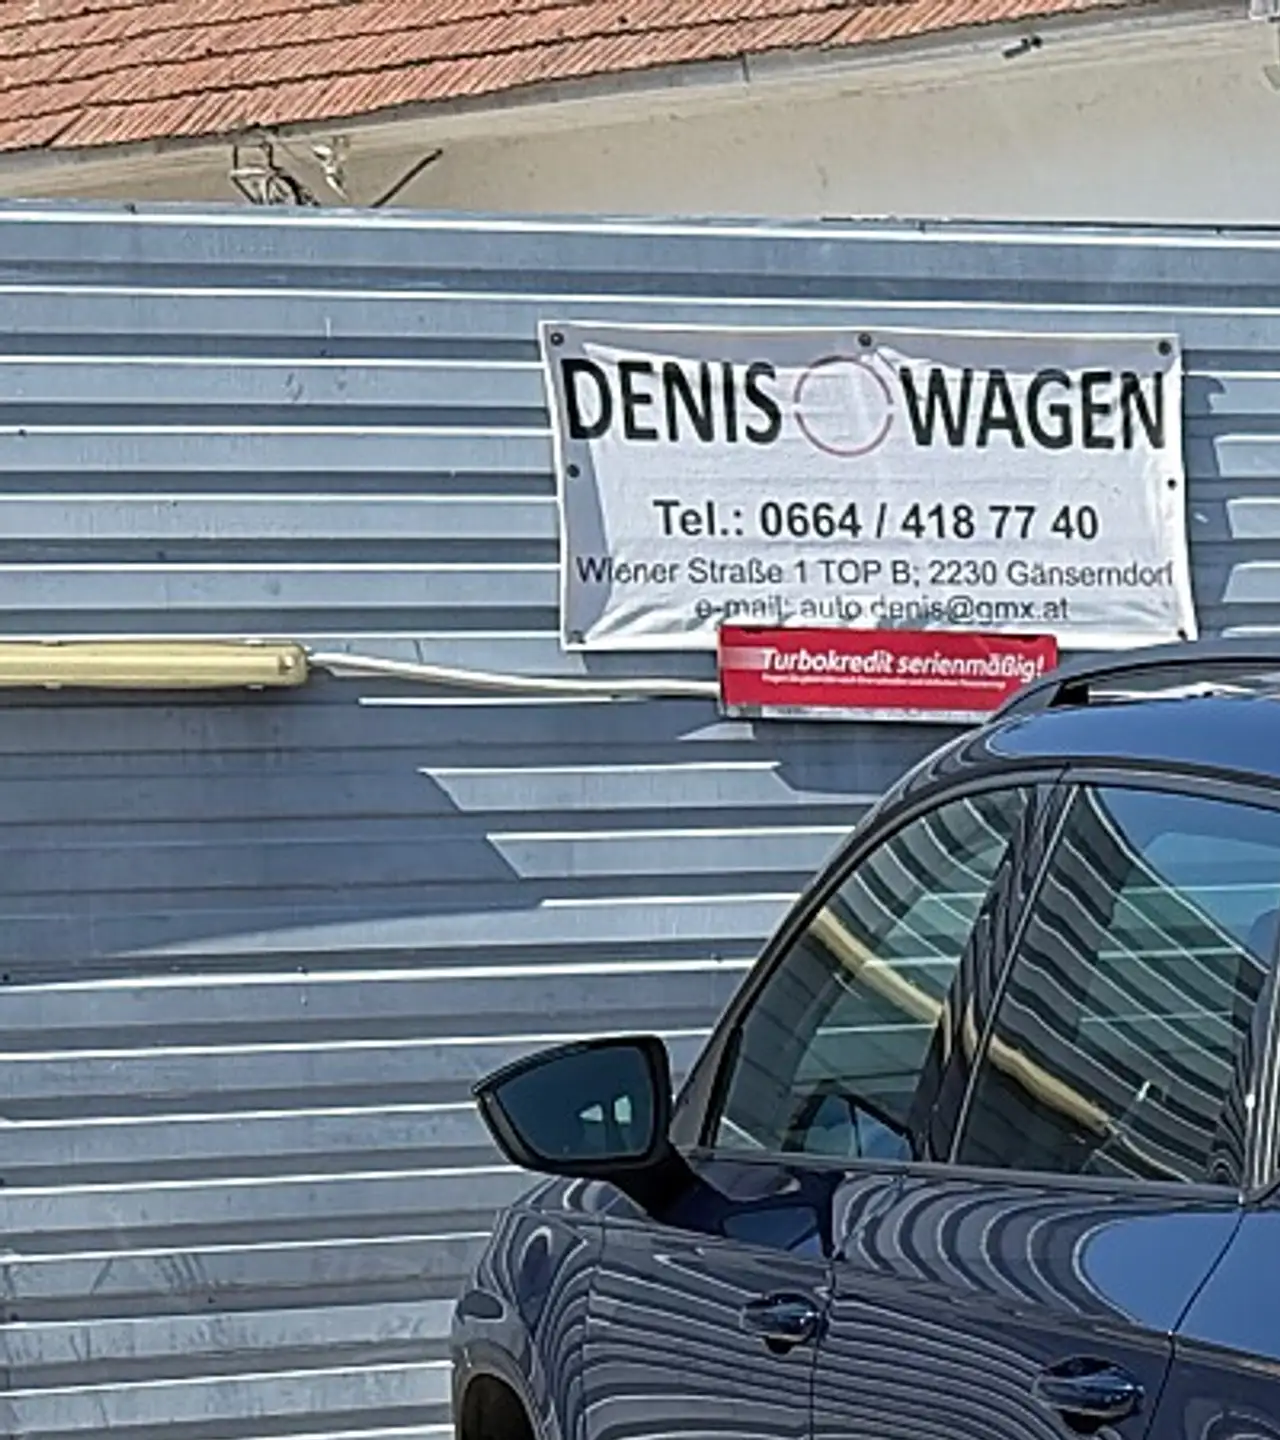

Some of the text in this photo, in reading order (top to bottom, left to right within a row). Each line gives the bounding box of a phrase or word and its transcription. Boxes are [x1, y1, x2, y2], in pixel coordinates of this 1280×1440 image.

[561, 358, 1166, 449] DENIS WAGEN
[653, 499, 744, 536] Tel.:
[760, 501, 862, 538] 0664
[900, 503, 975, 539] 418
[988, 505, 1036, 539] 77
[1050, 505, 1099, 540] 40
[576, 556, 679, 585] Wiener
[688, 557, 782, 585] Straße
[795, 560, 807, 584] 1
[817, 560, 882, 584] TOP
[929, 560, 998, 586] 2230
[1007, 559, 1174, 587] Gänserndorf
[762, 648, 892, 674] Turbokredit
[897, 653, 1044, 683] serienmäßig!
